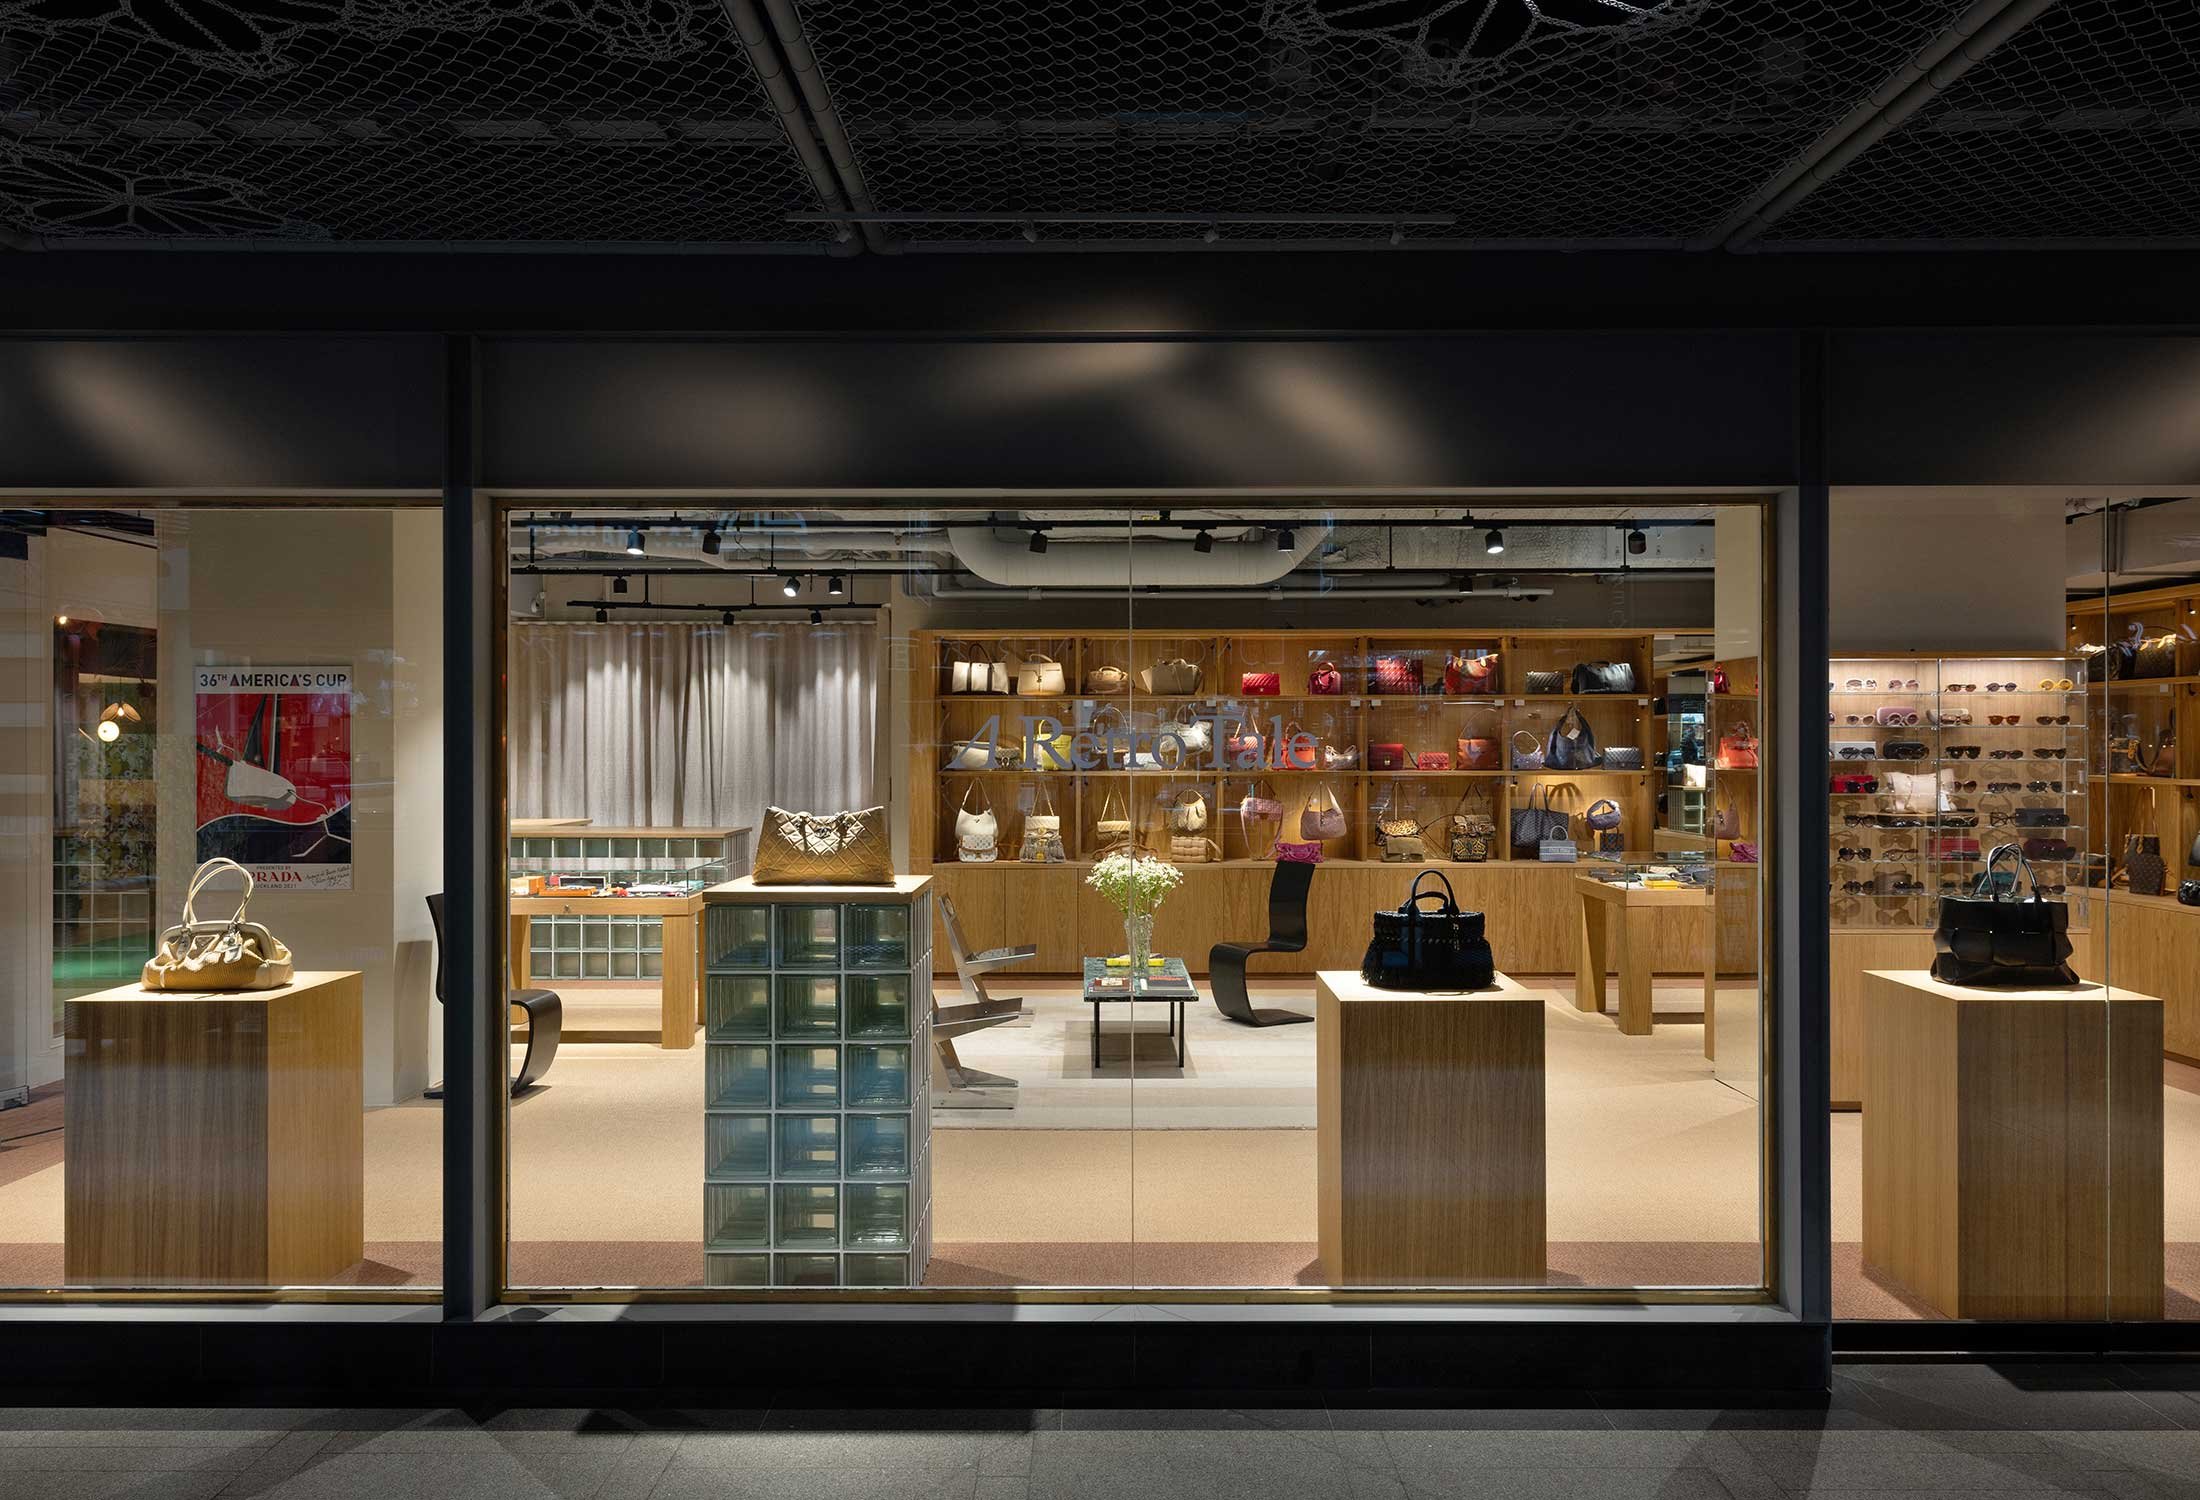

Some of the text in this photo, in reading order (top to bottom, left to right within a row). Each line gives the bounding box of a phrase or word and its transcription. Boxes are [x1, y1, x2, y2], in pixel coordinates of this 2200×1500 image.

[200, 673, 347, 687] 36TH AMERICA'S CUP
[942, 713, 1319, 770] A Retro Tale
